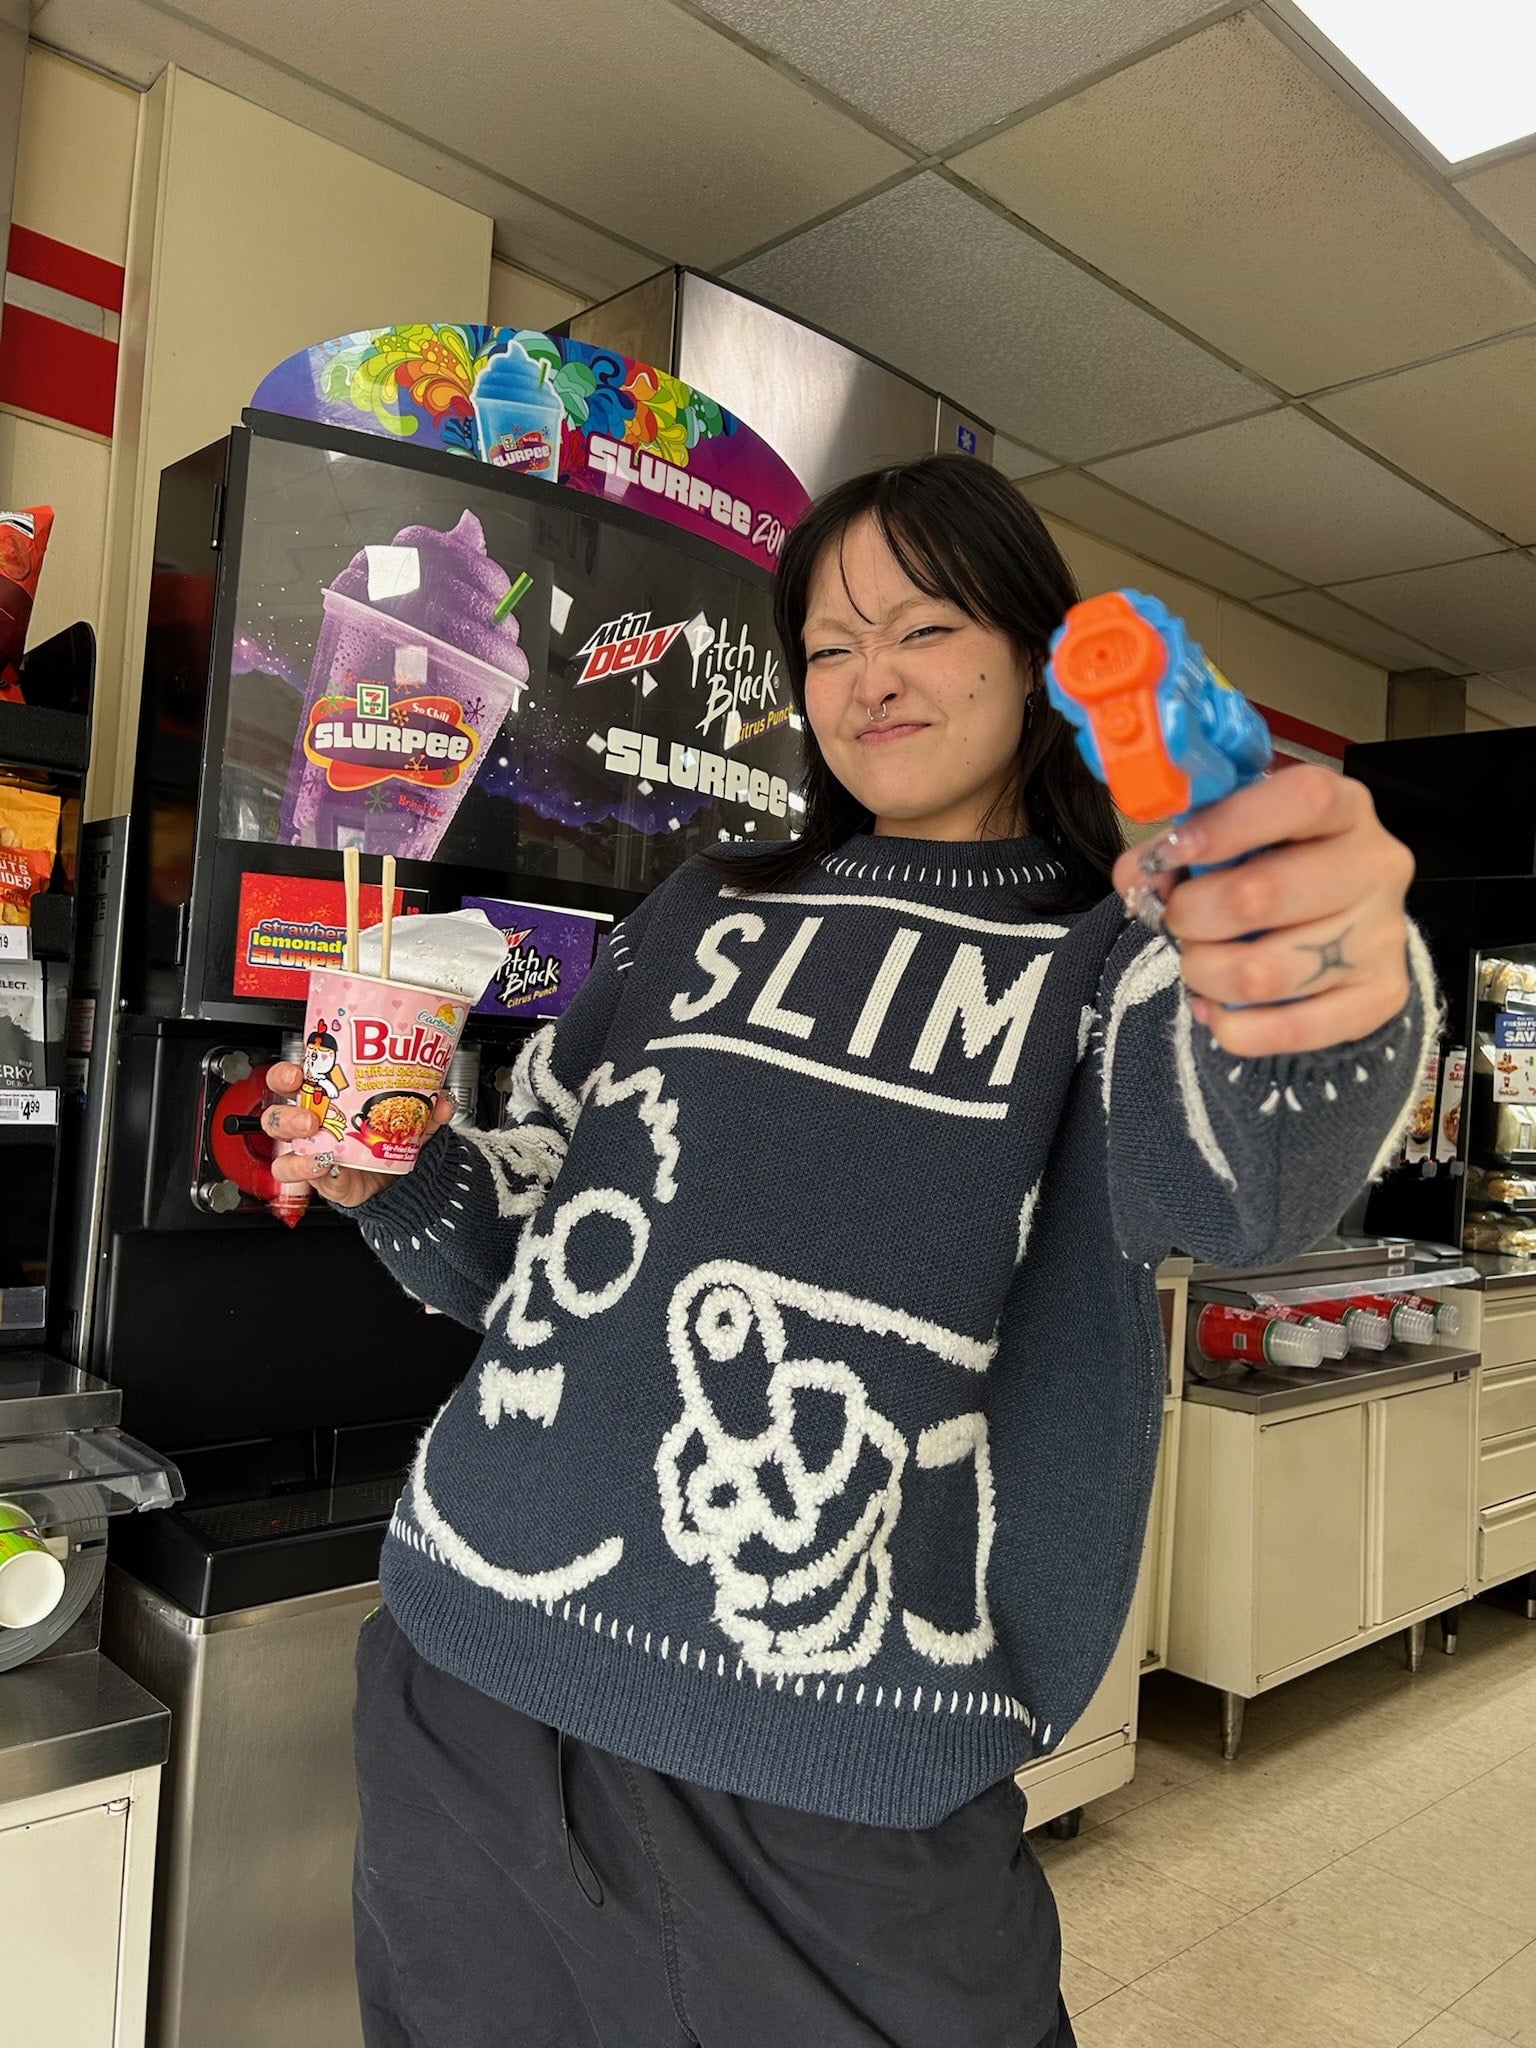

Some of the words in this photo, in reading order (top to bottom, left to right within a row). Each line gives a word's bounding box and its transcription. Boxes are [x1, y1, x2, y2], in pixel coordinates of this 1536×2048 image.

[584, 615, 648, 651] Mtn
[690, 617, 755, 689] Pitch
[411, 702, 425, 714] So
[426, 707, 450, 723] Chill
[695, 649, 779, 737] Black
[498, 958, 560, 1002] Black
[507, 995, 532, 1009] Citrus
[533, 984, 558, 1000] Punch
[669, 912, 1054, 1087] SLIM
[354, 1018, 452, 1071] Buldak
